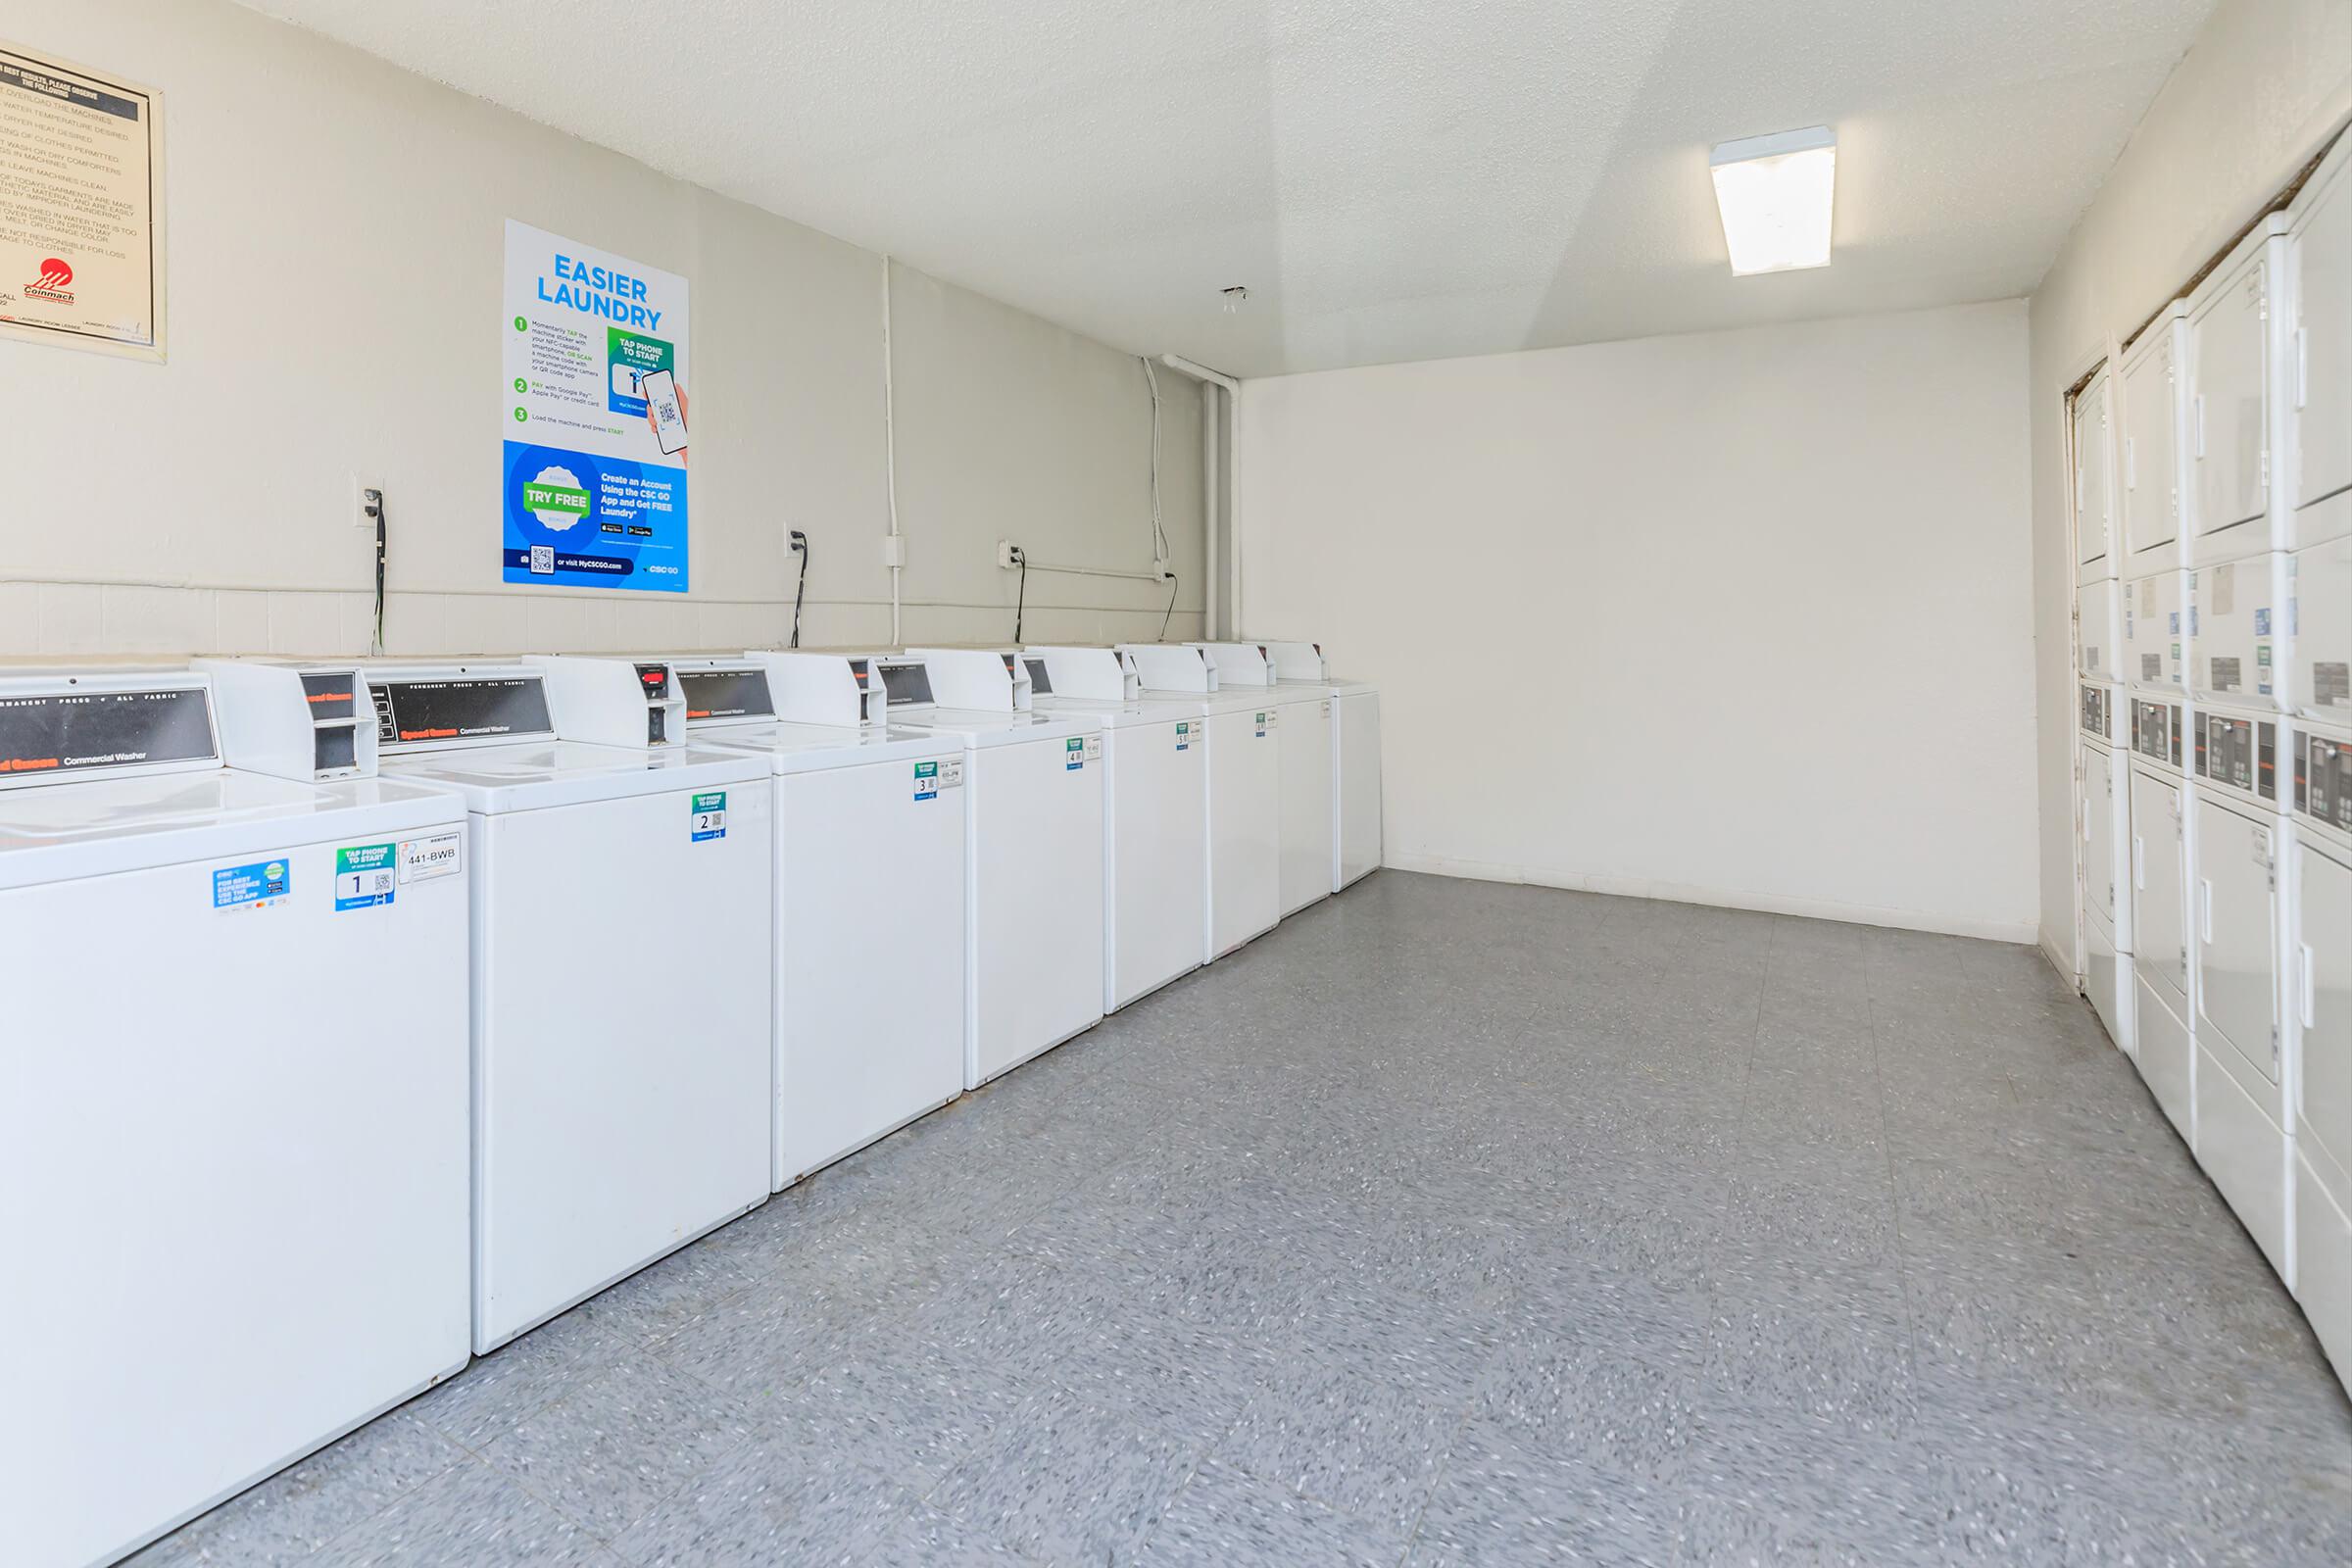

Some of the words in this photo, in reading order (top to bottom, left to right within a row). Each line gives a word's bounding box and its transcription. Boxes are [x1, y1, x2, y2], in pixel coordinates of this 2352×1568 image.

[54, 102, 69, 113] THE
[3, 102, 32, 114] WATER
[34, 110, 92, 131] TEMPERATURE
[34, 122, 55, 133] HEAT
[34, 135, 73, 150] CLOTHES
[7, 141, 31, 152] WASH
[67, 157, 122, 175] COMFORTERS
[8, 162, 33, 173] LEAVE
[36, 169, 79, 185] MACHINES
[31, 187, 71, 203] MATERIAL
[92, 202, 106, 211] ARE
[48, 185, 93, 201] GARMENTS
[95, 196, 110, 206] ARE
[112, 200, 134, 212] MADE
[16, 204, 52, 217] WASHED
[64, 215, 90, 225] WATER
[92, 221, 110, 230] THAT
[122, 227, 137, 236] TOO
[67, 222, 94, 232] DRYER
[45, 223, 79, 236] CHANGE
[10, 229, 27, 238] NOT
[87, 245, 104, 254] FOR
[555, 253, 647, 303] EASIER
[24, 286, 74, 301] Coinmach
[538, 276, 662, 331] LAUNDRY
[518, 319, 524, 329] 1
[532, 320, 565, 334] Momentarily
[532, 329, 555, 338] machine
[619, 338, 635, 347] TAP
[636, 342, 663, 356] PHONE
[537, 352, 560, 361] machine
[623, 347, 635, 356] TO
[636, 351, 660, 363] START
[546, 361, 578, 372] smartphone
[517, 381, 524, 391] 2
[629, 372, 637, 394] 1
[517, 410, 524, 419] 3
[558, 419, 580, 428] machine
[601, 473, 627, 484] Create
[641, 479, 672, 490] Account
[527, 490, 553, 503] TRY
[556, 493, 587, 508] FREE
[601, 484, 623, 496] Using
[640, 490, 657, 499] CSC
[658, 492, 670, 501] GO
[601, 495, 618, 506] App
[652, 502, 672, 513] FREE
[578, 561, 622, 569] MyCSCGO.com
[64, 754, 115, 766] Commercial
[116, 751, 147, 761] Washer
[701, 815, 709, 829] 2
[361, 853, 385, 862] START
[362, 847, 388, 856] PHONE
[409, 849, 456, 864] 441-BWB
[353, 875, 360, 894] 1
